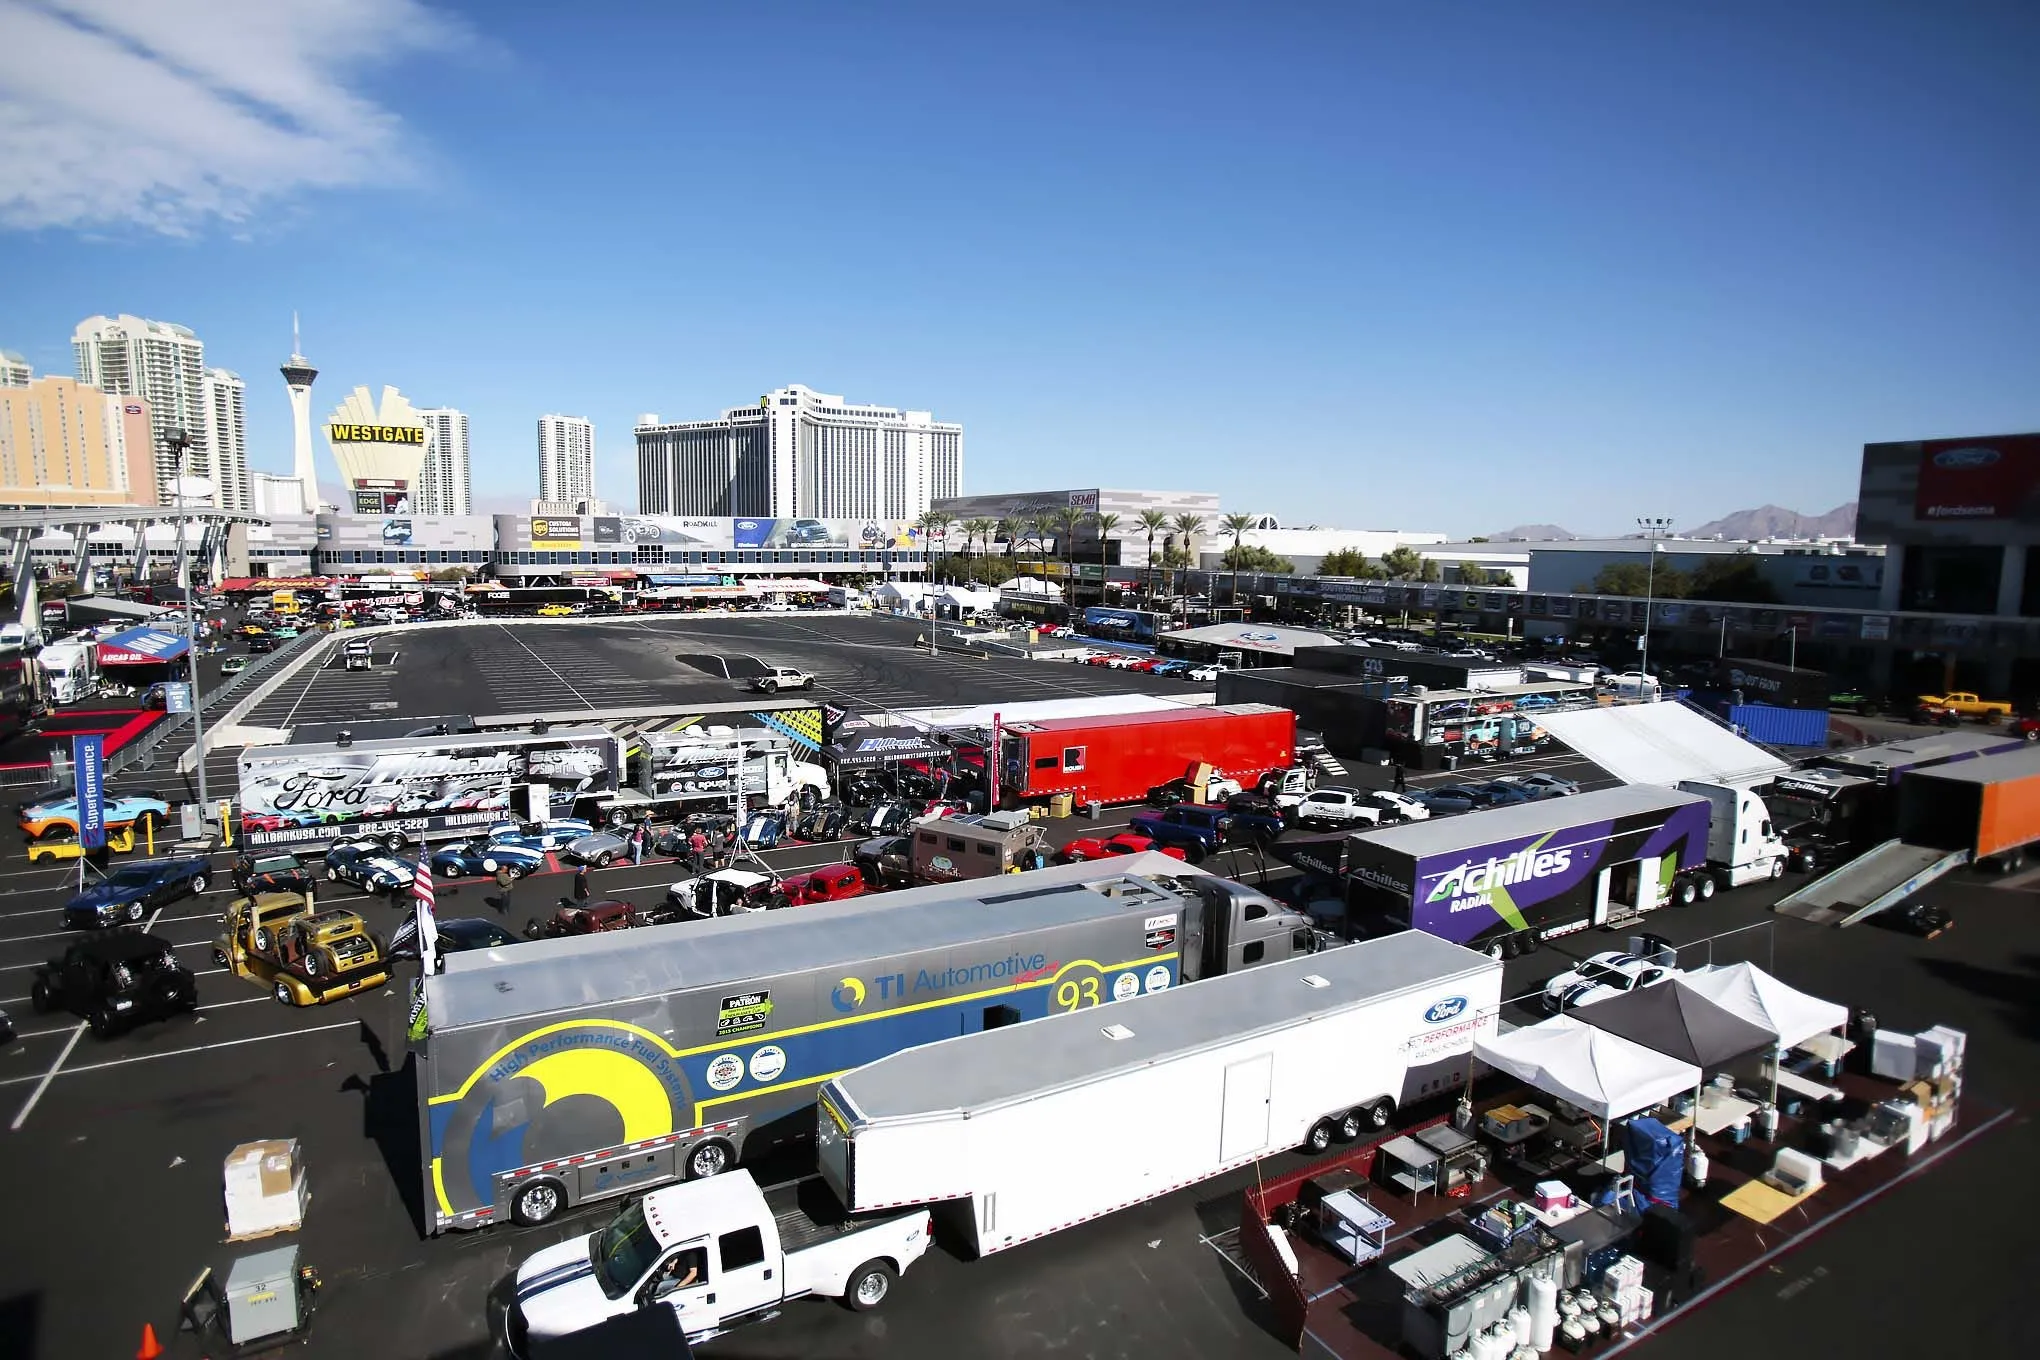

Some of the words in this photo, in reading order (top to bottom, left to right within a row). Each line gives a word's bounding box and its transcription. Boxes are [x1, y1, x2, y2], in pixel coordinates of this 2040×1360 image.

[332, 424, 424, 443] WESTGATE
[1070, 494, 1097, 505] SEMA
[1320, 583, 1344, 592] SOUTH
[1344, 585, 1368, 593] HALLS
[102, 653, 129, 661] LUCAS
[129, 653, 143, 661] OIL
[856, 737, 925, 752] Hillbank
[84, 744, 99, 830] Superformance
[273, 773, 371, 810] Ford
[1776, 780, 1830, 795] Achilles
[444, 810, 509, 827] HILLBANKUSA.C
[1292, 851, 1335, 874] Achilles
[1352, 867, 1409, 892] Achilles
[1424, 849, 1572, 904] Achilles
[1449, 892, 1494, 914] RADIAL
[874, 973, 905, 1000] TI
[912, 952, 1046, 993] Automotive
[1057, 976, 1101, 1012] 93
[1431, 998, 1463, 1021] Ford
[732, 1023, 763, 1033] CHAMPIONS
[1423, 1016, 1489, 1044] PERFORMANCE
[490, 1052, 528, 1082] High
[529, 1033, 630, 1057] Performance
[628, 1037, 661, 1064] Fuel
[656, 1058, 688, 1111] Systems
